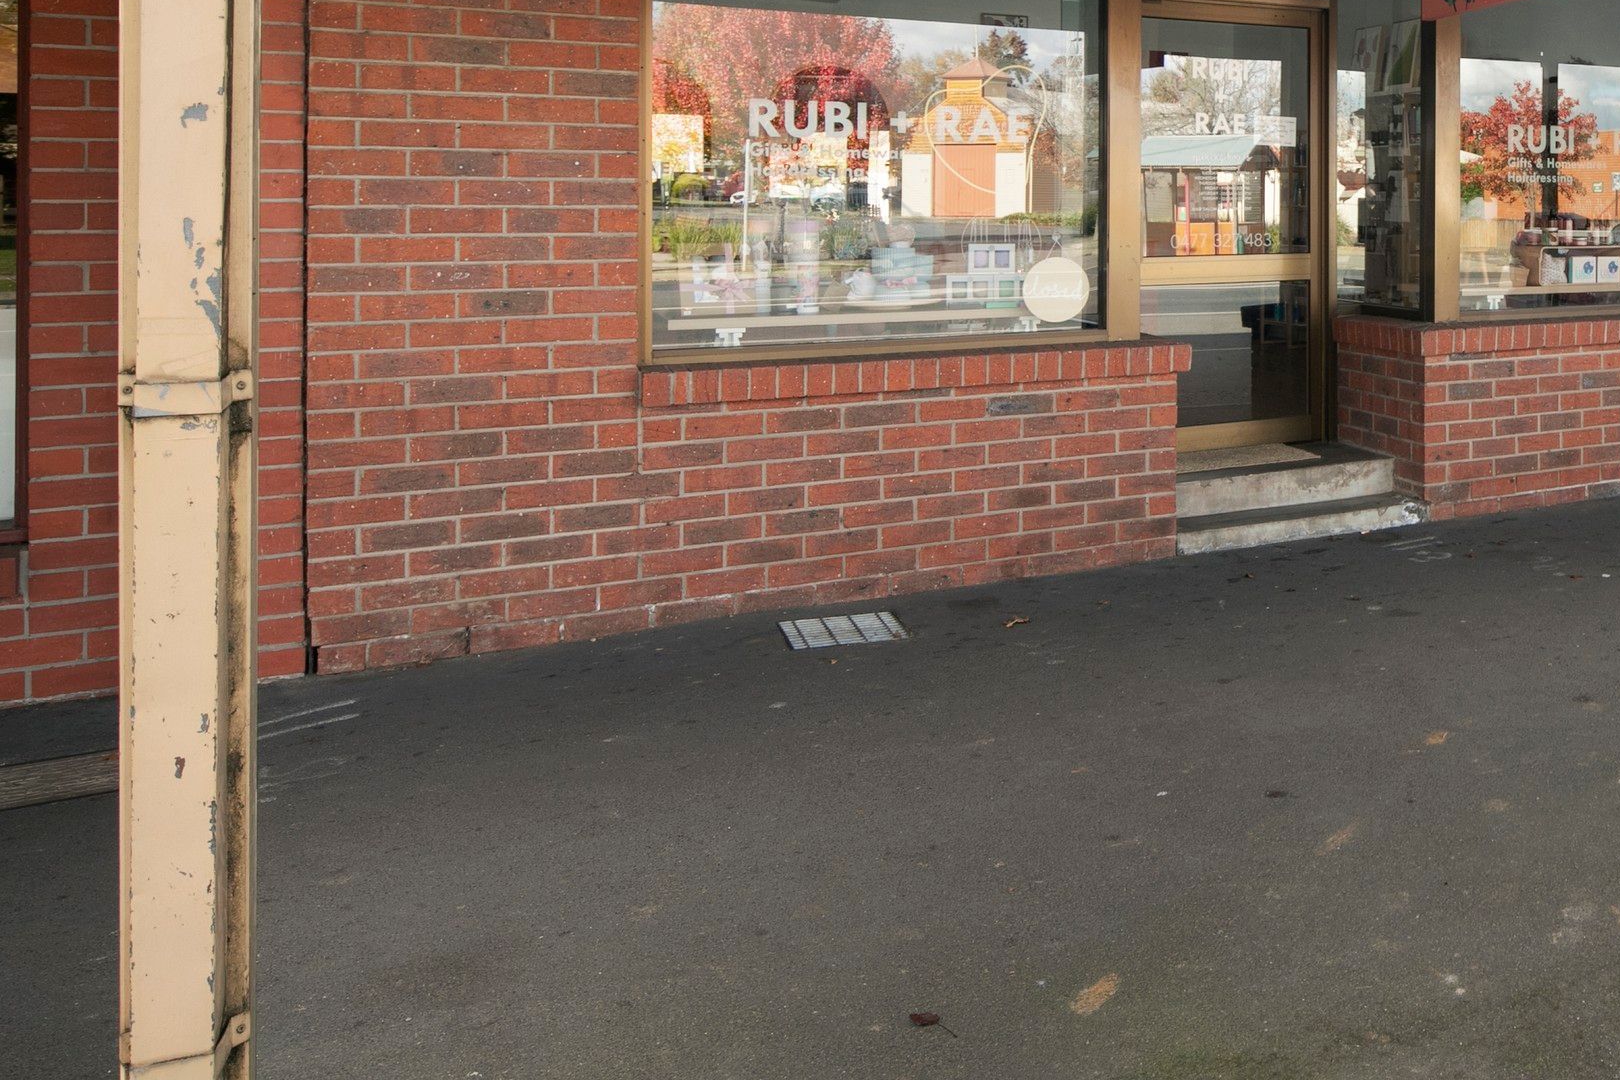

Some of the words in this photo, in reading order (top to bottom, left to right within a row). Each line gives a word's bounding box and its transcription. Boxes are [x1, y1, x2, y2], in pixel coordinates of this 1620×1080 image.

[749, 98, 868, 141] RUBI
[936, 105, 1032, 145] RAE
[1195, 112, 1246, 135] RAE
[1507, 124, 1576, 155] RUBI
[1507, 157, 1533, 169] Gifts
[1547, 157, 1608, 170] Homewares
[1507, 172, 1573, 185] Hairdressing
[1170, 233, 1208, 249] 0477
[1245, 232, 1273, 247] 483
